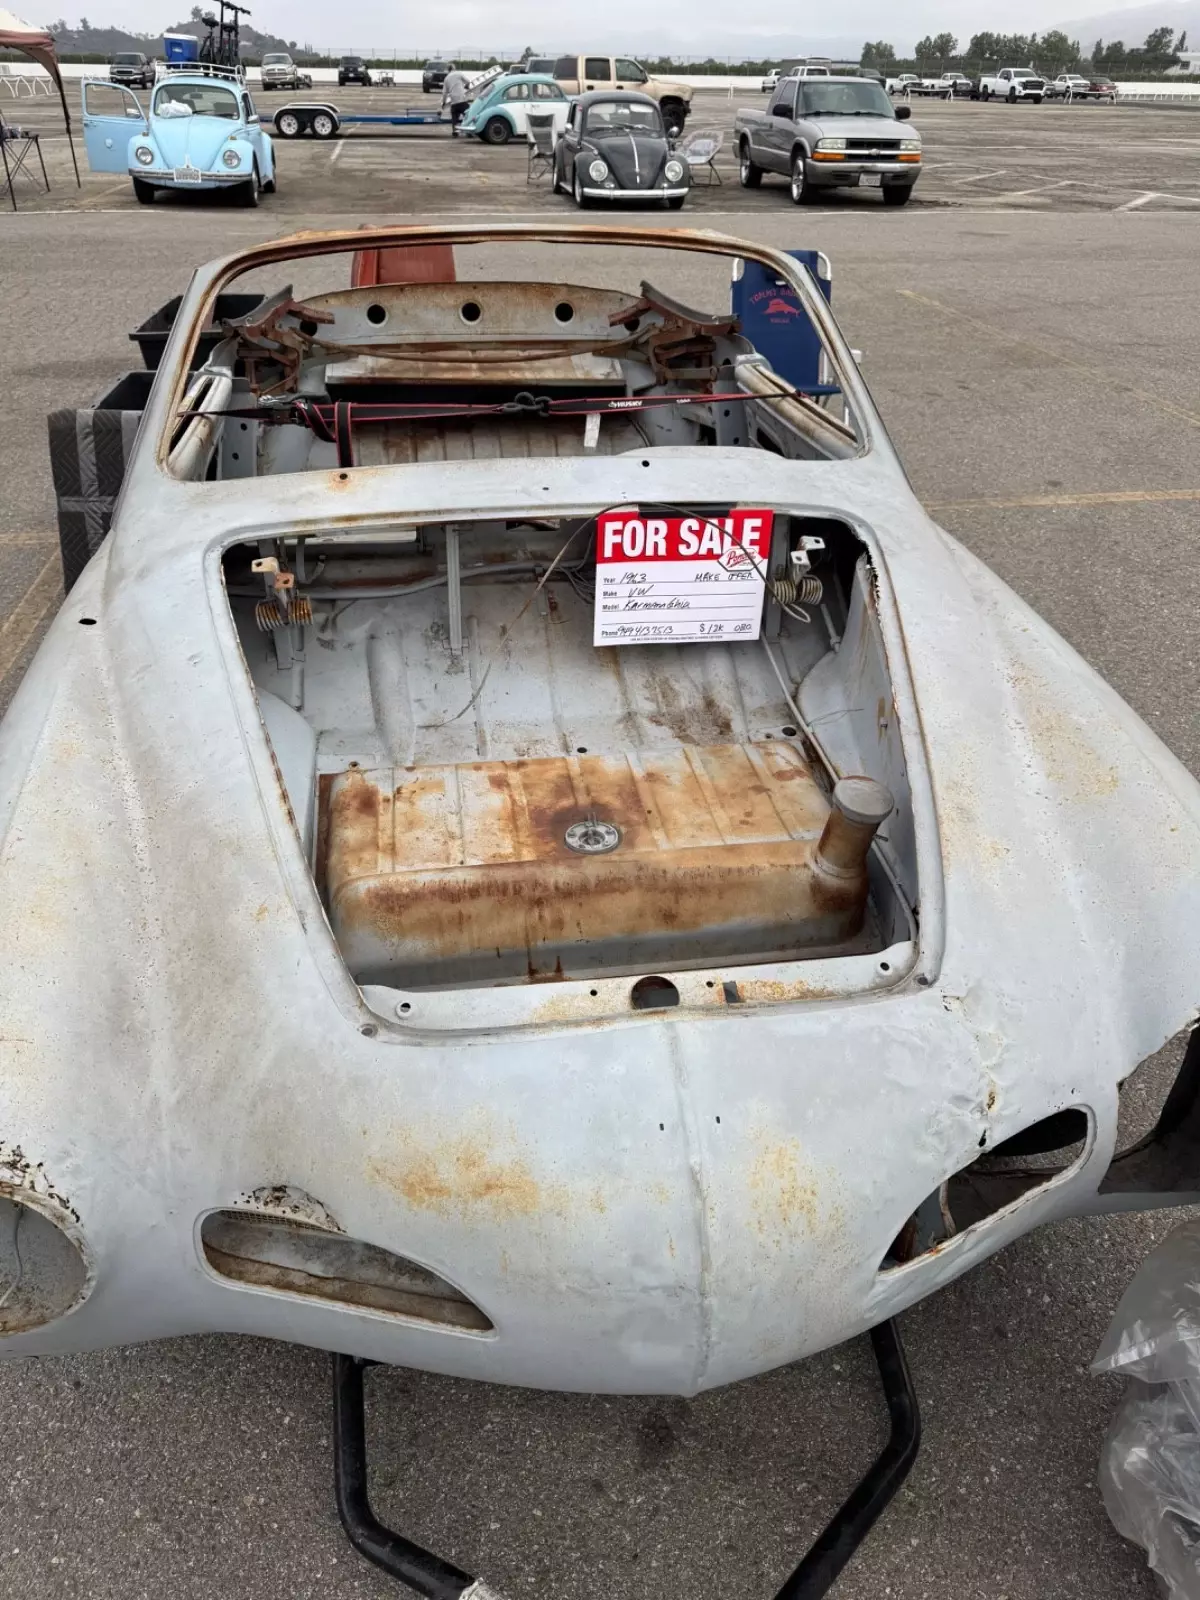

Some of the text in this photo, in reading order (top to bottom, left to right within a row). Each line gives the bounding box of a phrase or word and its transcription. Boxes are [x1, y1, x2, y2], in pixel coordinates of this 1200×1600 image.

[603, 517, 763, 558] FOR SALE
[694, 571, 754, 582] MAKE OFFER
[628, 584, 655, 598] VW
